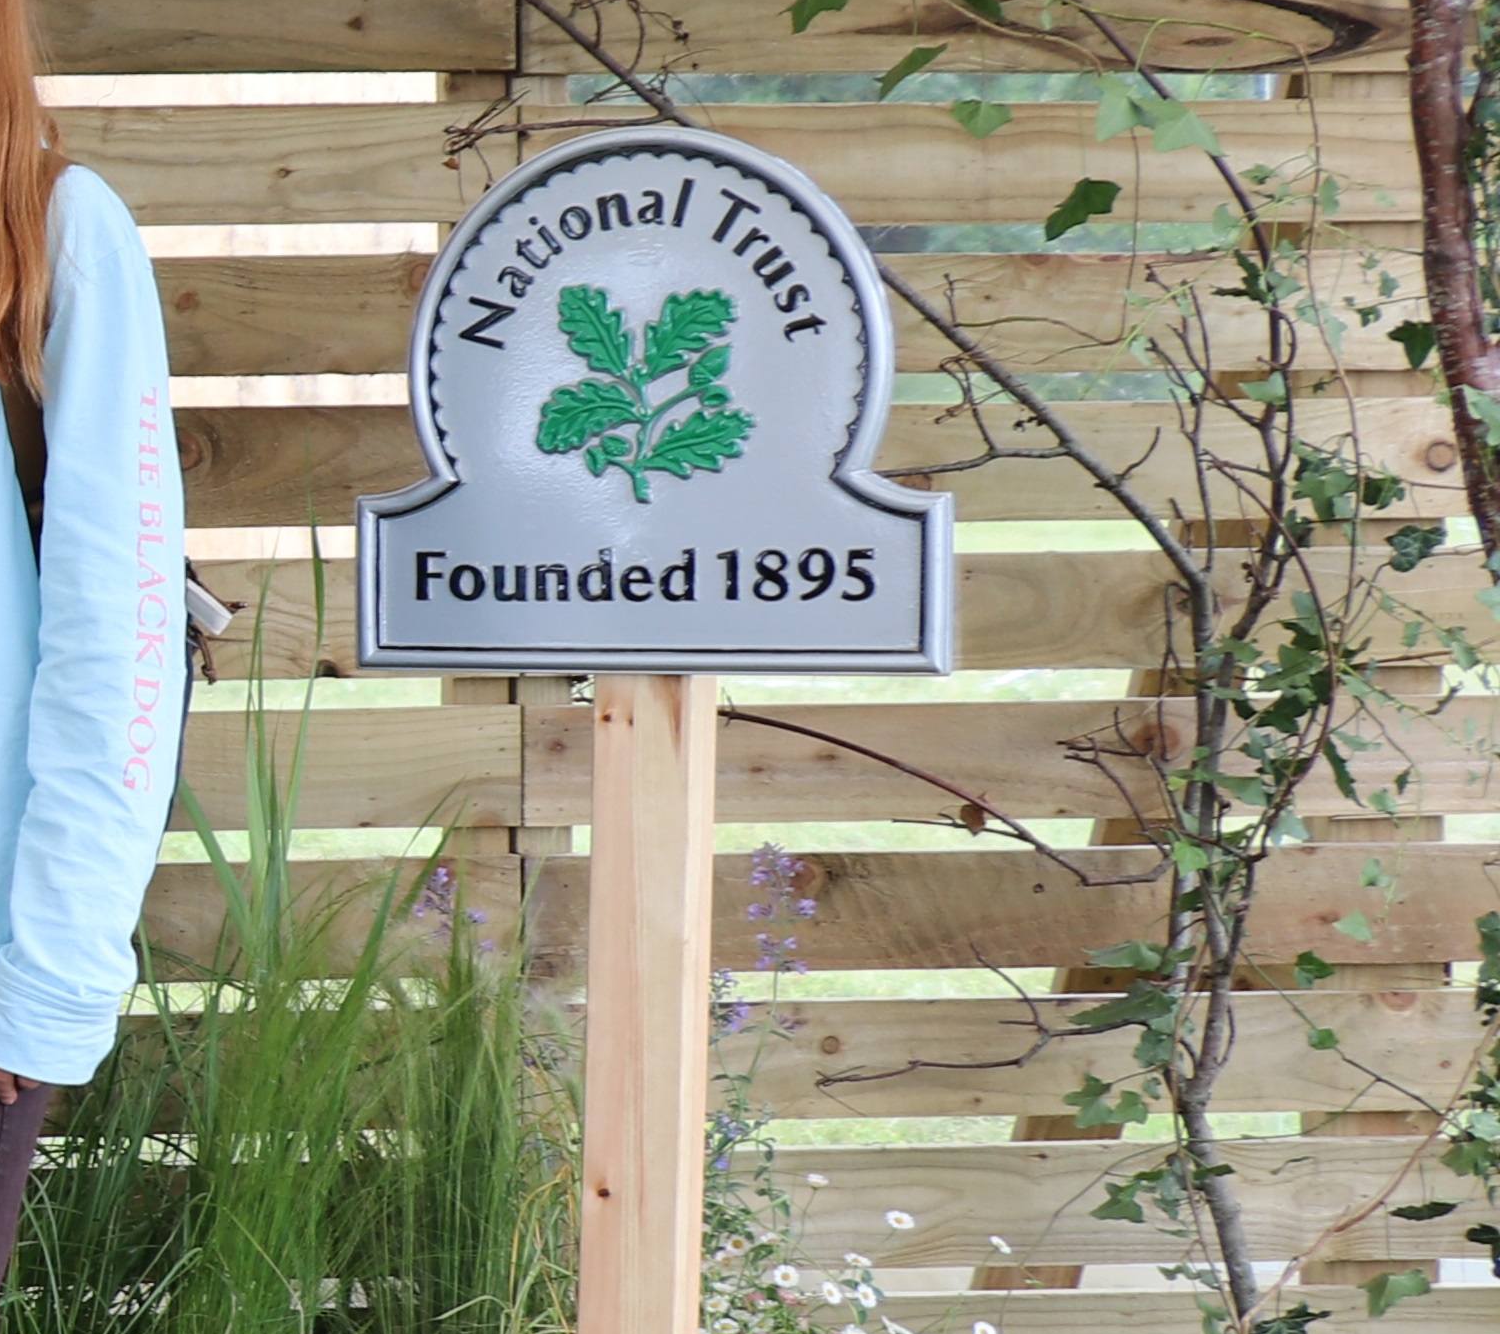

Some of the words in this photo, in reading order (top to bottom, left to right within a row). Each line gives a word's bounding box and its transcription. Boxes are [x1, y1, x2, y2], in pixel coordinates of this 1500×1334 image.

[457, 178, 695, 350] National
[710, 186, 829, 344] Trust
[138, 385, 161, 489] THE
[135, 499, 169, 669] BLACK
[414, 547, 696, 603] Founded
[717, 547, 877, 604] 1895
[122, 673, 162, 793] DOG
